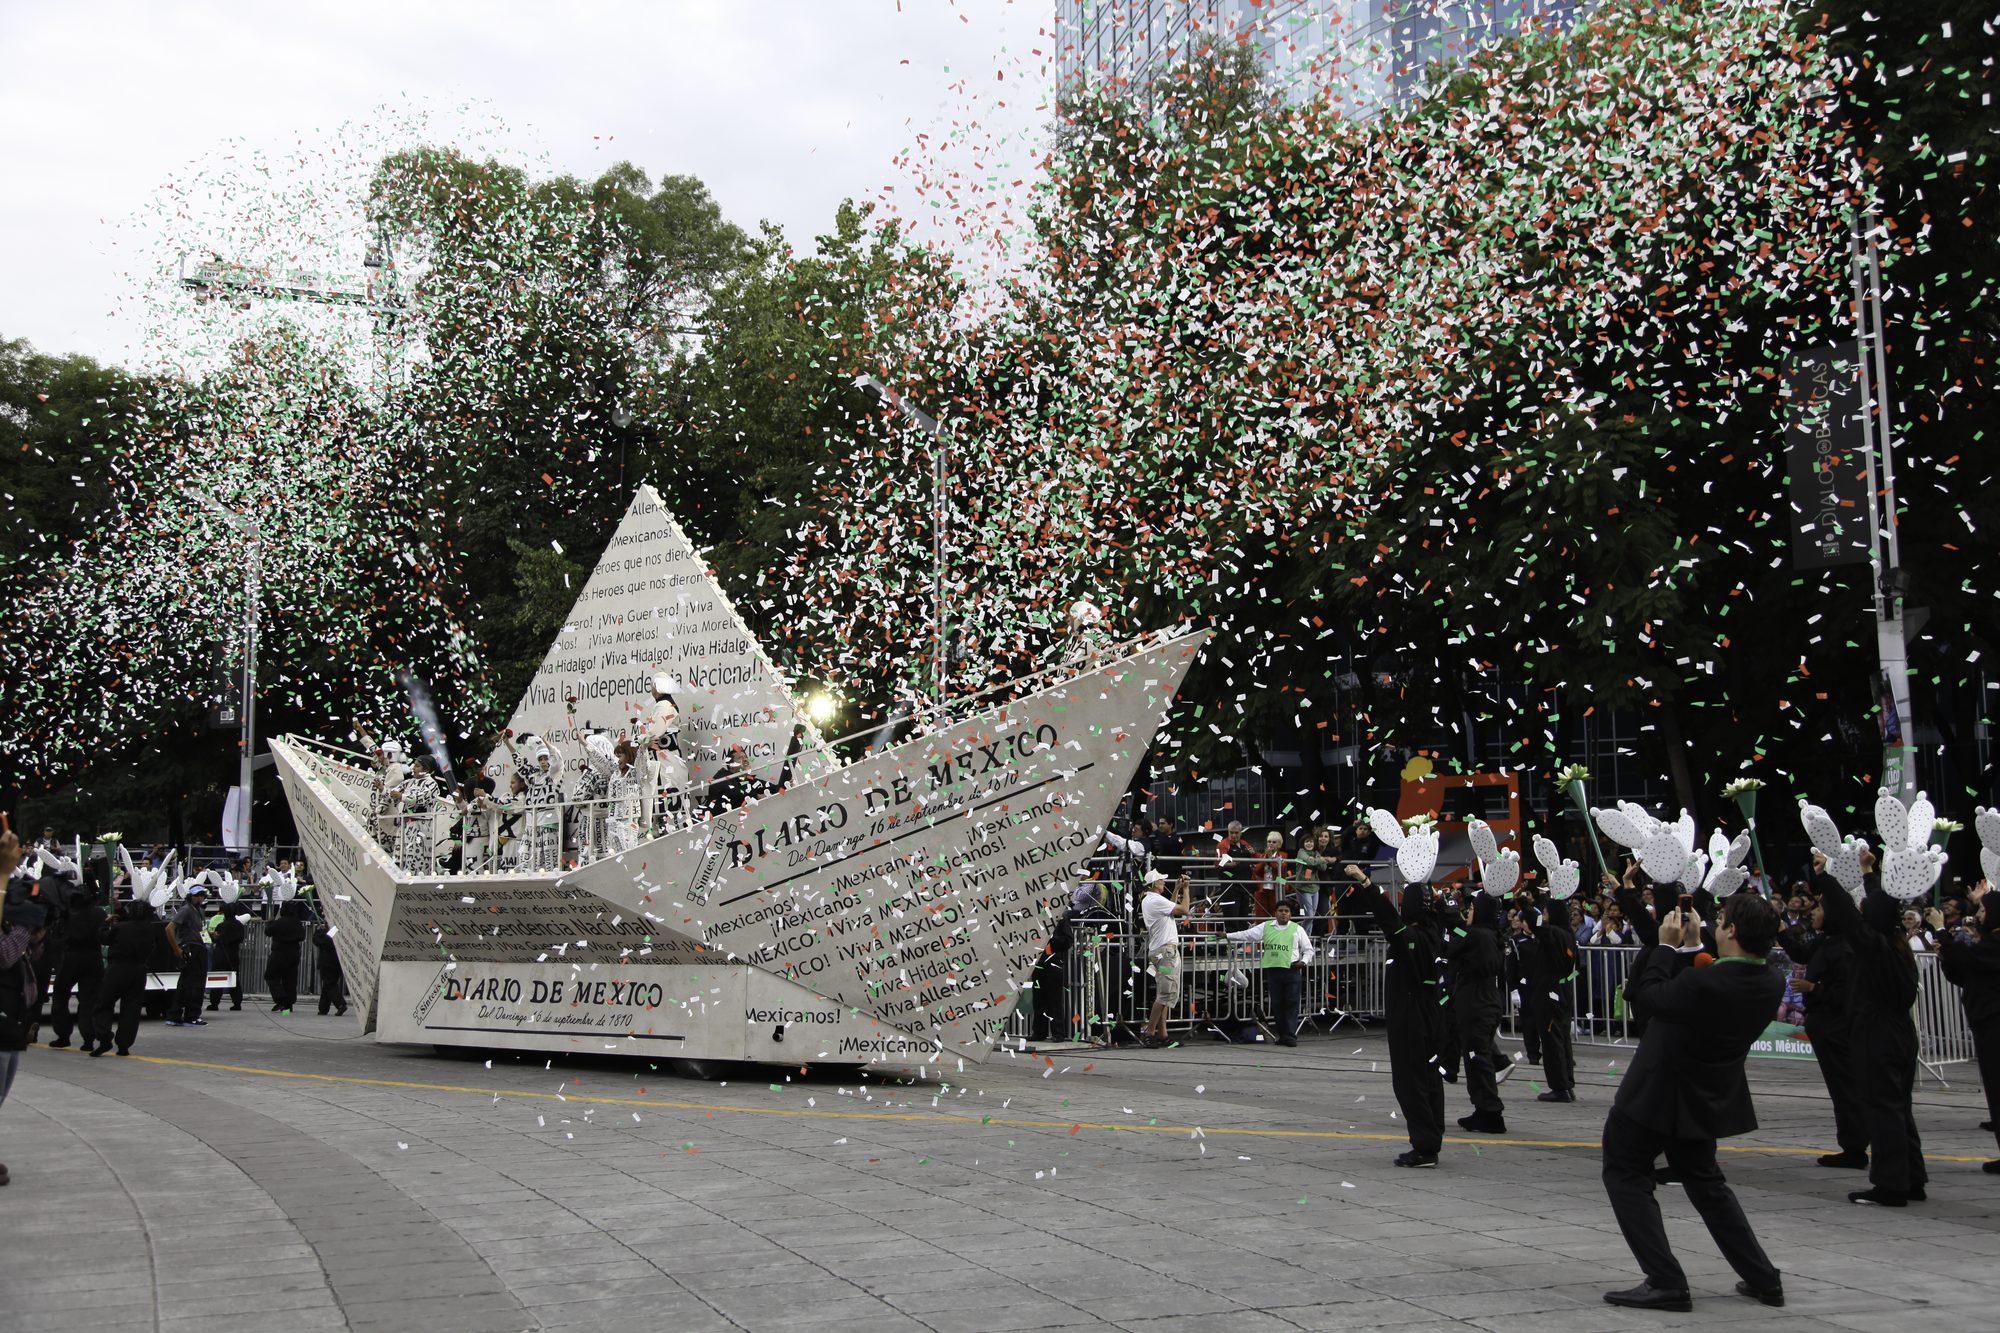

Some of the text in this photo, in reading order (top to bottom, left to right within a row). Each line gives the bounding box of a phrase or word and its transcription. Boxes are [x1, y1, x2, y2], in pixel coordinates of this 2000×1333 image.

[1812, 363, 1831, 439] BACAS
[631, 502, 658, 517] Allen
[611, 527, 672, 549] ¡Mexicanos!
[624, 557, 642, 571] que
[645, 553, 662, 567] nos
[592, 585, 625, 600] Heroes
[628, 580, 647, 593] que
[650, 577, 666, 590] nos
[670, 573, 703, 590] dieron
[627, 603, 679, 623] Guerero!
[589, 633, 613, 649] ¡Viva
[616, 627, 659, 643] Morelos!
[539, 663, 553, 675] iva
[556, 656, 596, 674] Hidalgo!
[602, 651, 627, 669] ¡Viva
[631, 645, 673, 665] Hidalgo!
[679, 643, 705, 662] ¡Viva
[524, 658, 763, 711] ¡Viva la Independeia Nacional!
[687, 716, 718, 732] ¡Viva
[727, 724, 1058, 869] DIARIO DE MEXICO
[870, 818, 885, 837] 16
[714, 836, 726, 850] de
[960, 864, 1009, 889] ¡Viva
[512, 888, 549, 900] dieron
[447, 905, 487, 916] Heroes
[532, 904, 569, 915] dieron
[568, 902, 612, 915] Patria!
[704, 897, 796, 943] ¡Mexicanos!
[452, 918, 577, 939] Independencia
[569, 916, 661, 937] Nacional!
[835, 939, 885, 961] ¡Viva
[899, 927, 971, 963] Morelos!
[907, 946, 979, 984] Hidalgo!
[440, 972, 449, 984] de
[444, 978, 663, 1007] DIARIO DE MEXICO
[478, 1005, 497, 1018] Del
[495, 1006, 528, 1027] Domingo
[542, 1011, 551, 1023] de
[553, 1012, 595, 1027] septiembre
[595, 1014, 606, 1026] de
[608, 1013, 634, 1027] 1810
[838, 1034, 944, 1055] ¡Mexicanos!
[1775, 1039, 1813, 1054] México
